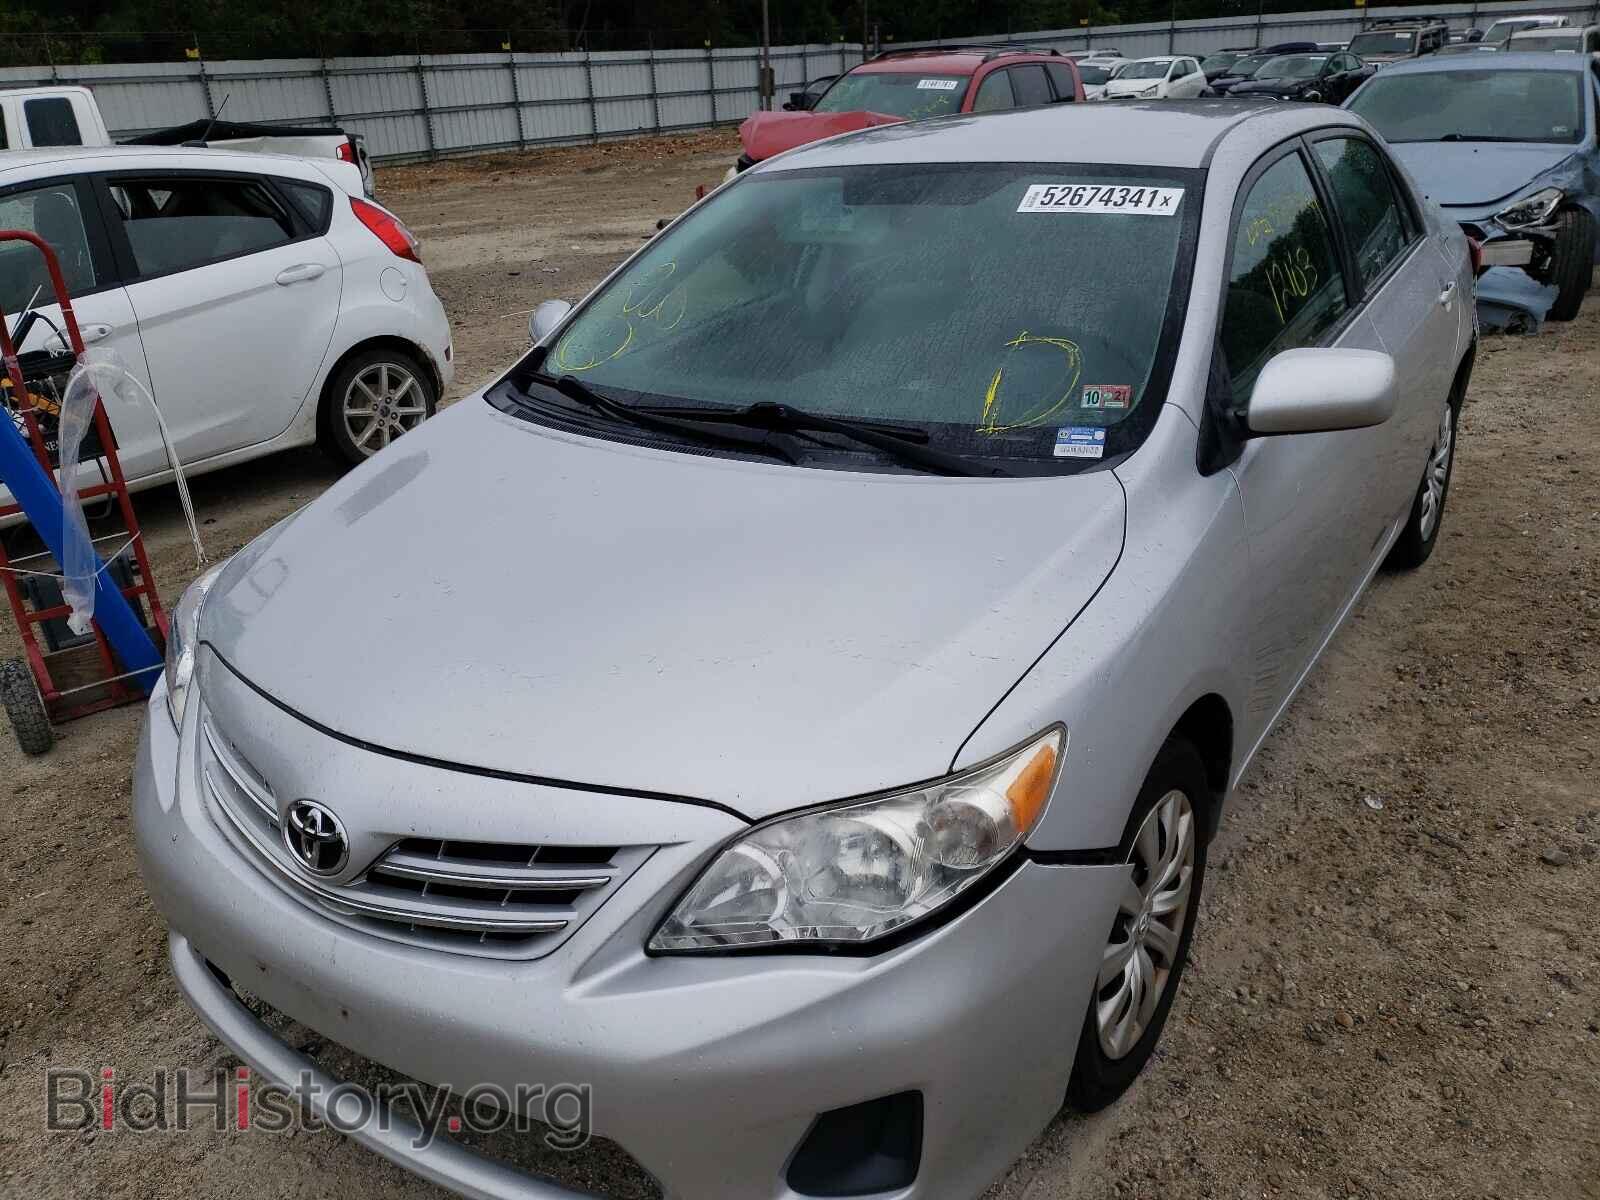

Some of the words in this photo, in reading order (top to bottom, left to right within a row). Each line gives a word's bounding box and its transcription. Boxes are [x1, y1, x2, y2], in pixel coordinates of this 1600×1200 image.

[1039, 186, 1160, 209] 52674341
[1085, 391, 1100, 405] 10
[1114, 390, 1127, 401] 21
